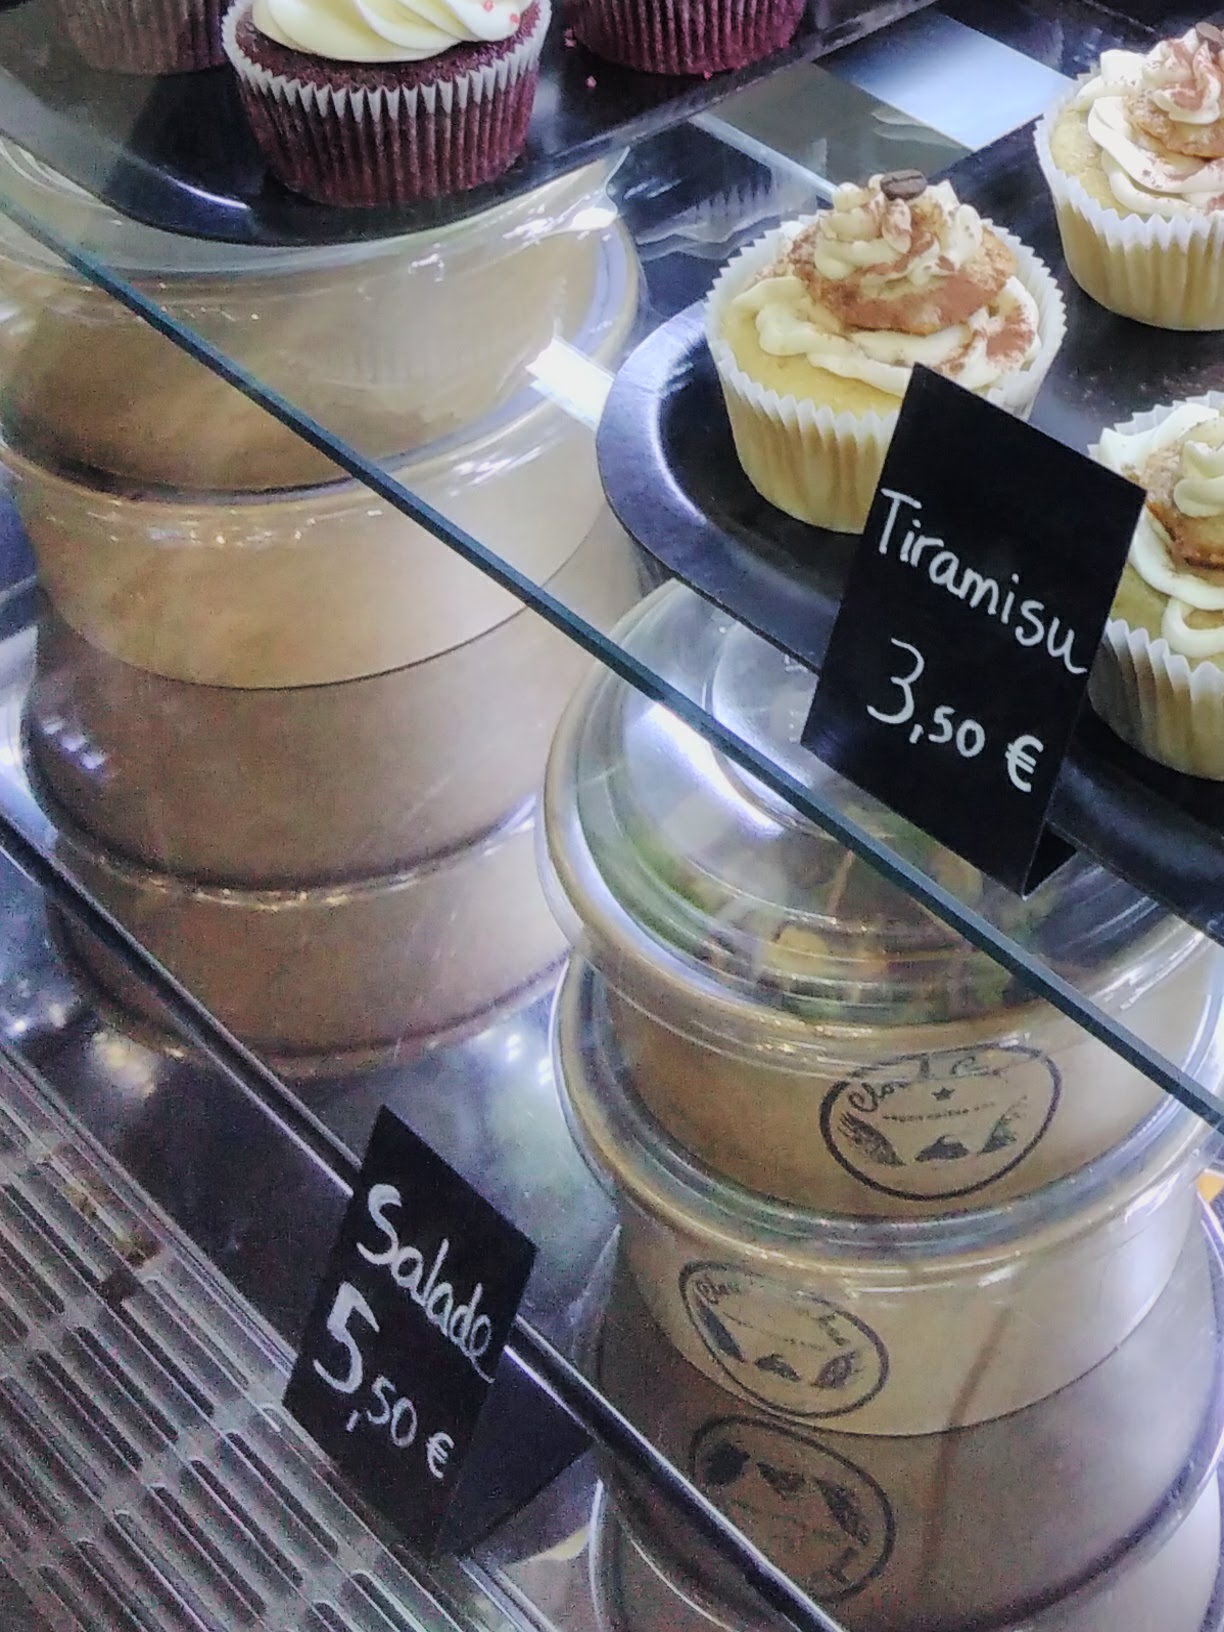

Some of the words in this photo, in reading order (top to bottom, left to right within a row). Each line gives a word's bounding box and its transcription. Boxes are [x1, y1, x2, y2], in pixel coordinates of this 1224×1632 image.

[880, 487, 1088, 676] Tiramisu
[866, 637, 987, 759] 3,50
[1004, 733, 1044, 793] €
[312, 1280, 418, 1448] 5,50
[355, 1182, 496, 1384] Salade
